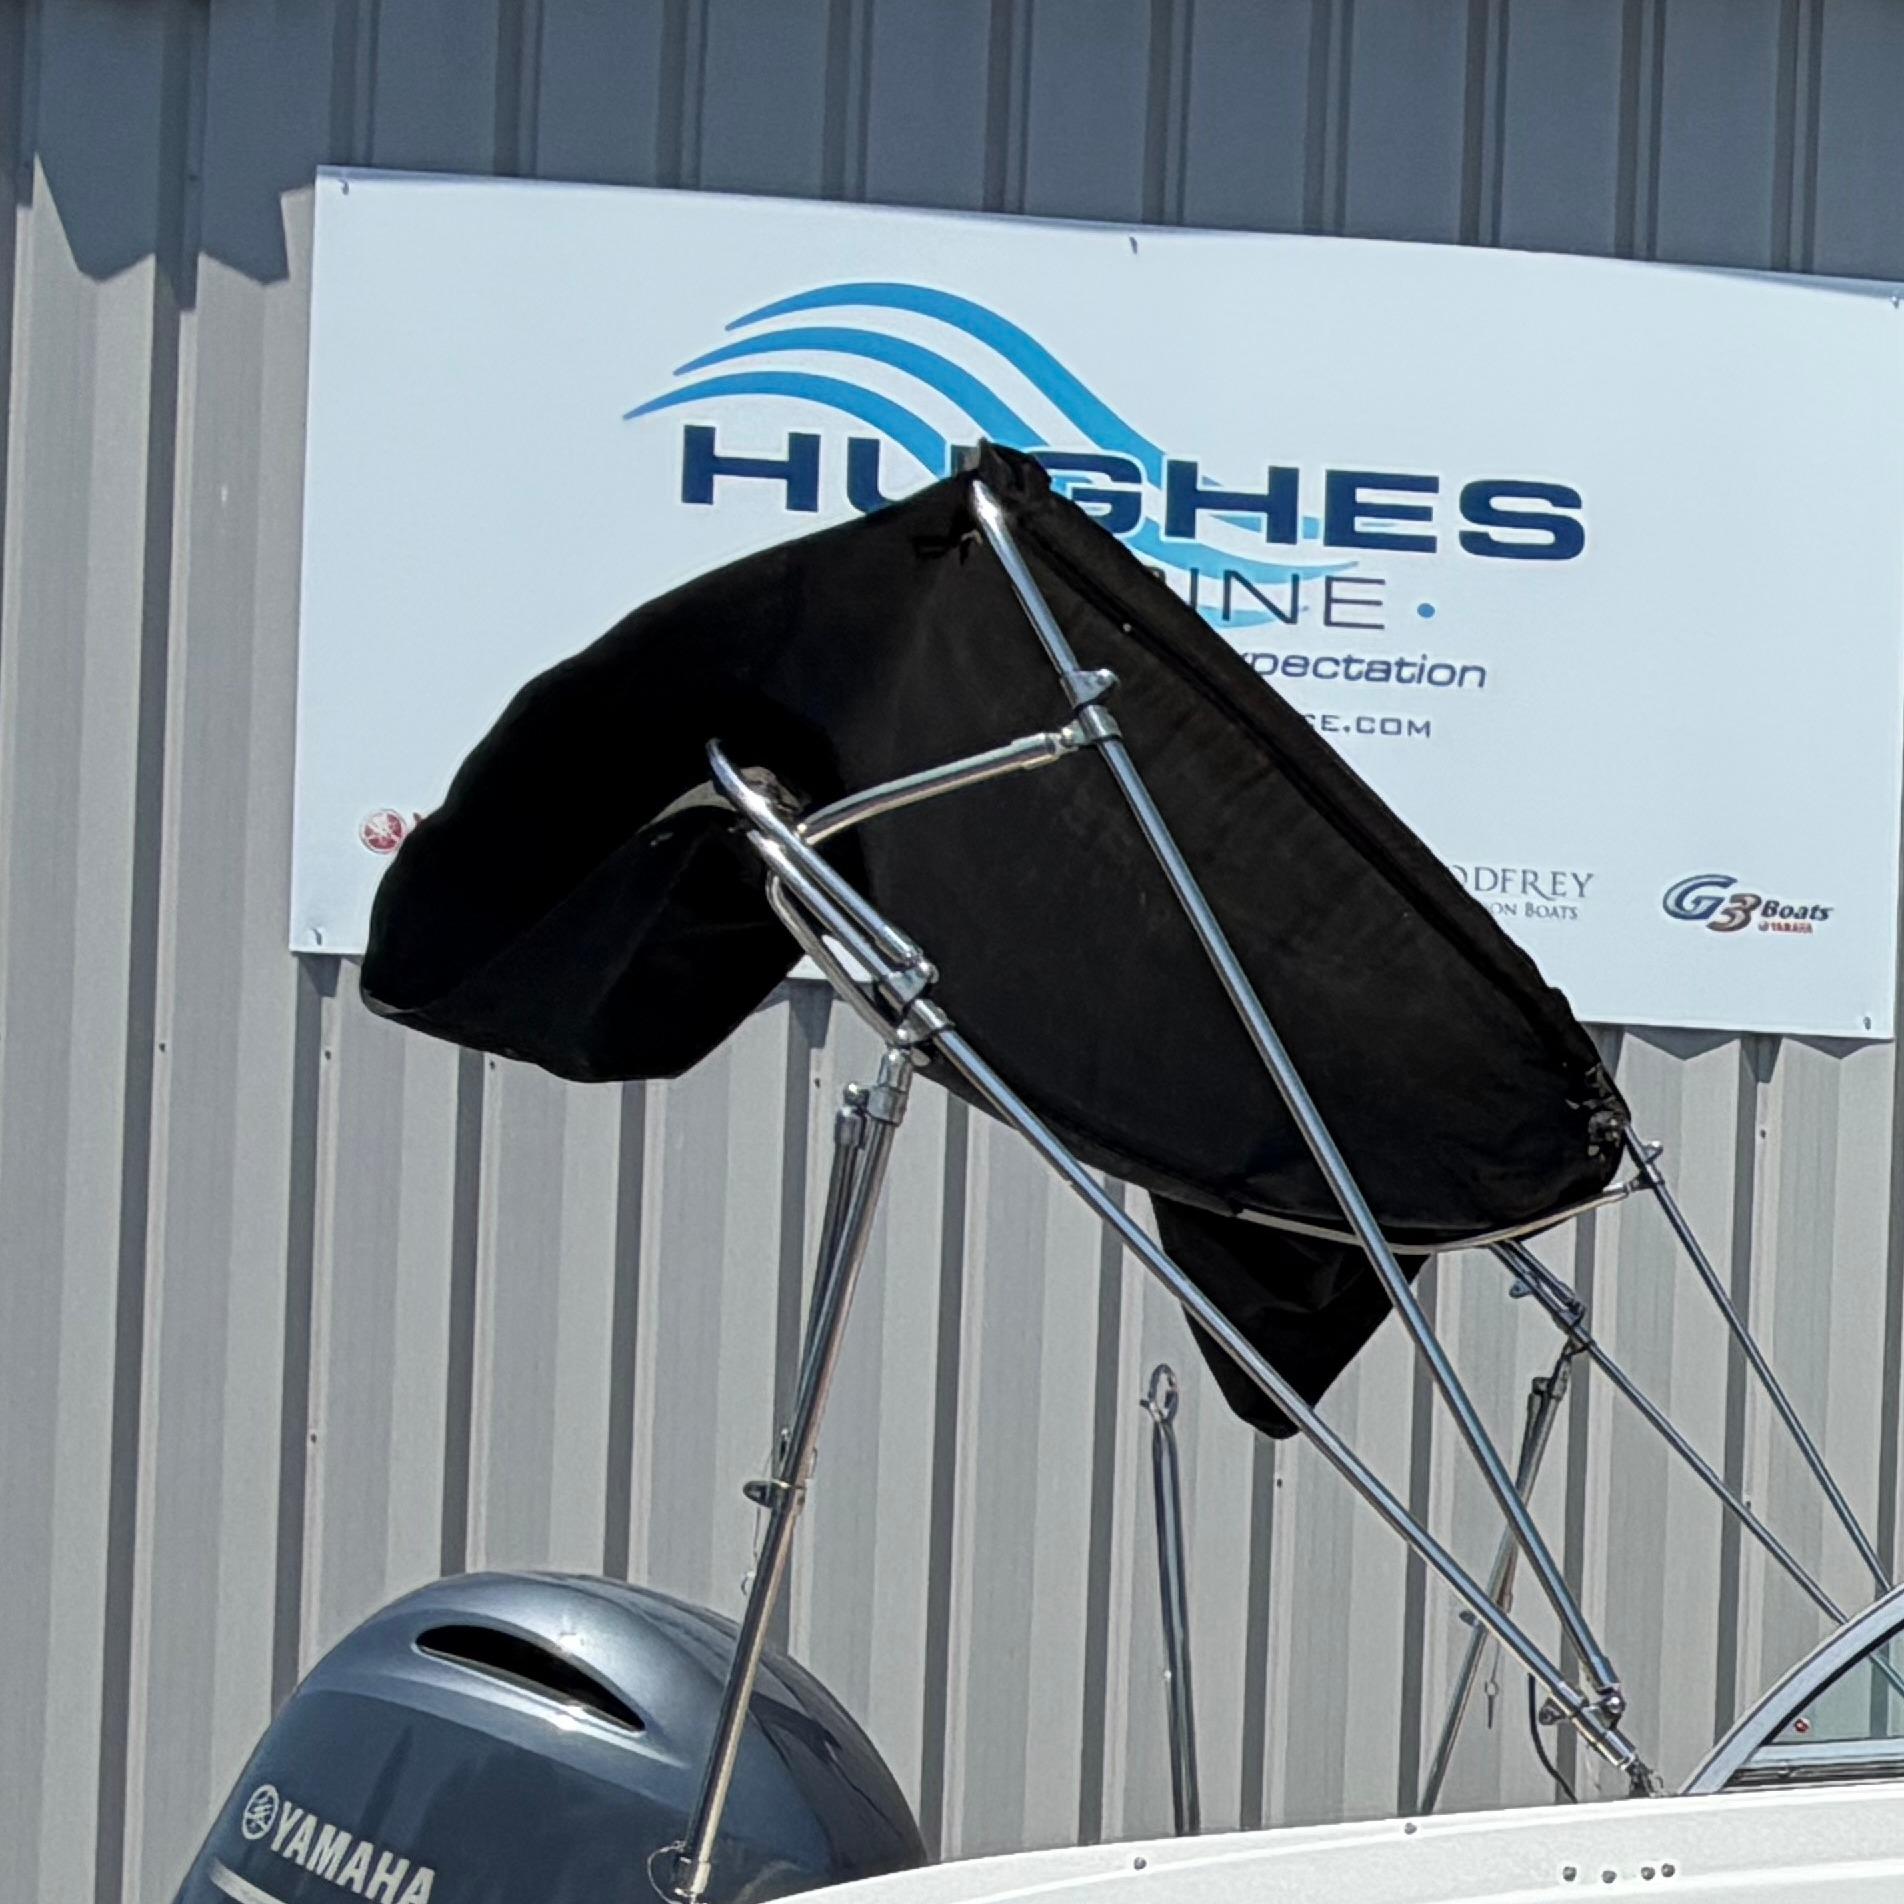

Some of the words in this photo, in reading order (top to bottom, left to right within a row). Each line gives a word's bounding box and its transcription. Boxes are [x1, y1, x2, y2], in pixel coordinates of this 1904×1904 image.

[1144, 565, 1386, 630] INE
[1243, 652, 1486, 688] pectation
[1759, 899, 1833, 921] Boats
